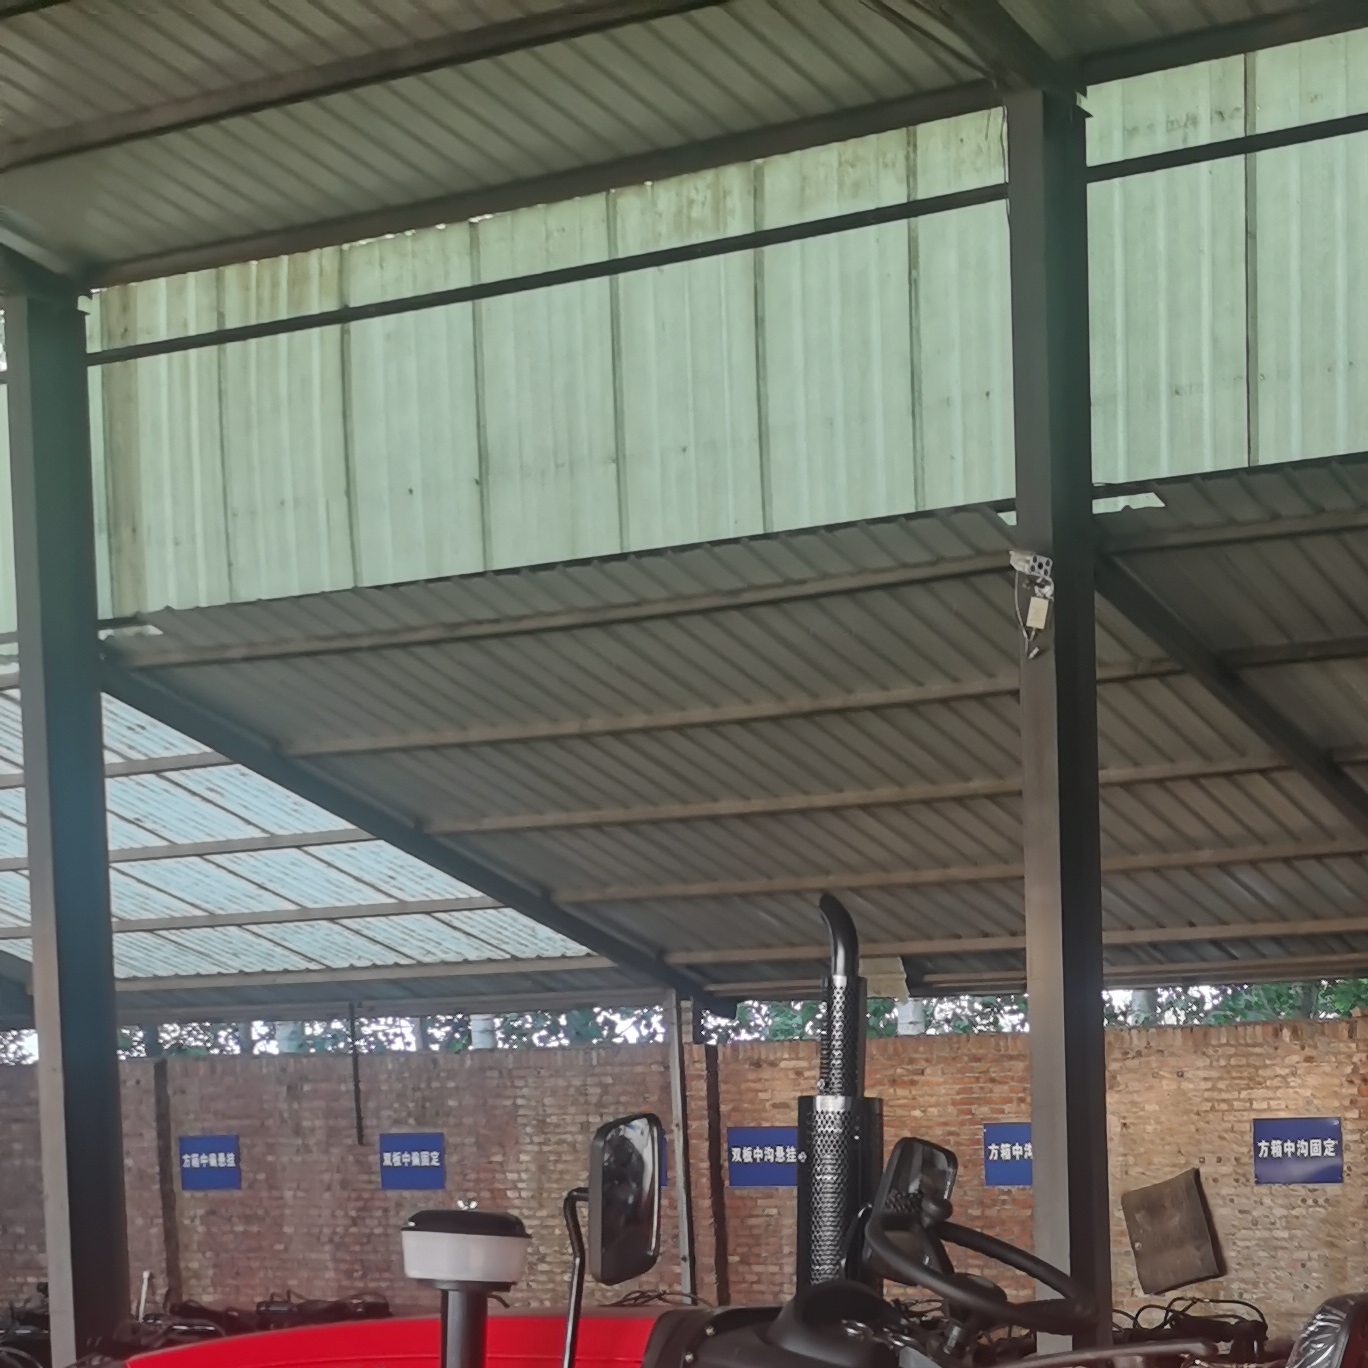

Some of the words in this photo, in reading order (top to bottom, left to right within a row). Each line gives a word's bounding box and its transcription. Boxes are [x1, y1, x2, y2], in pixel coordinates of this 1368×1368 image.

[731, 1145, 798, 1163] 双板中沟悬挂
[1257, 1138, 1334, 1158] 方箱中沟固定
